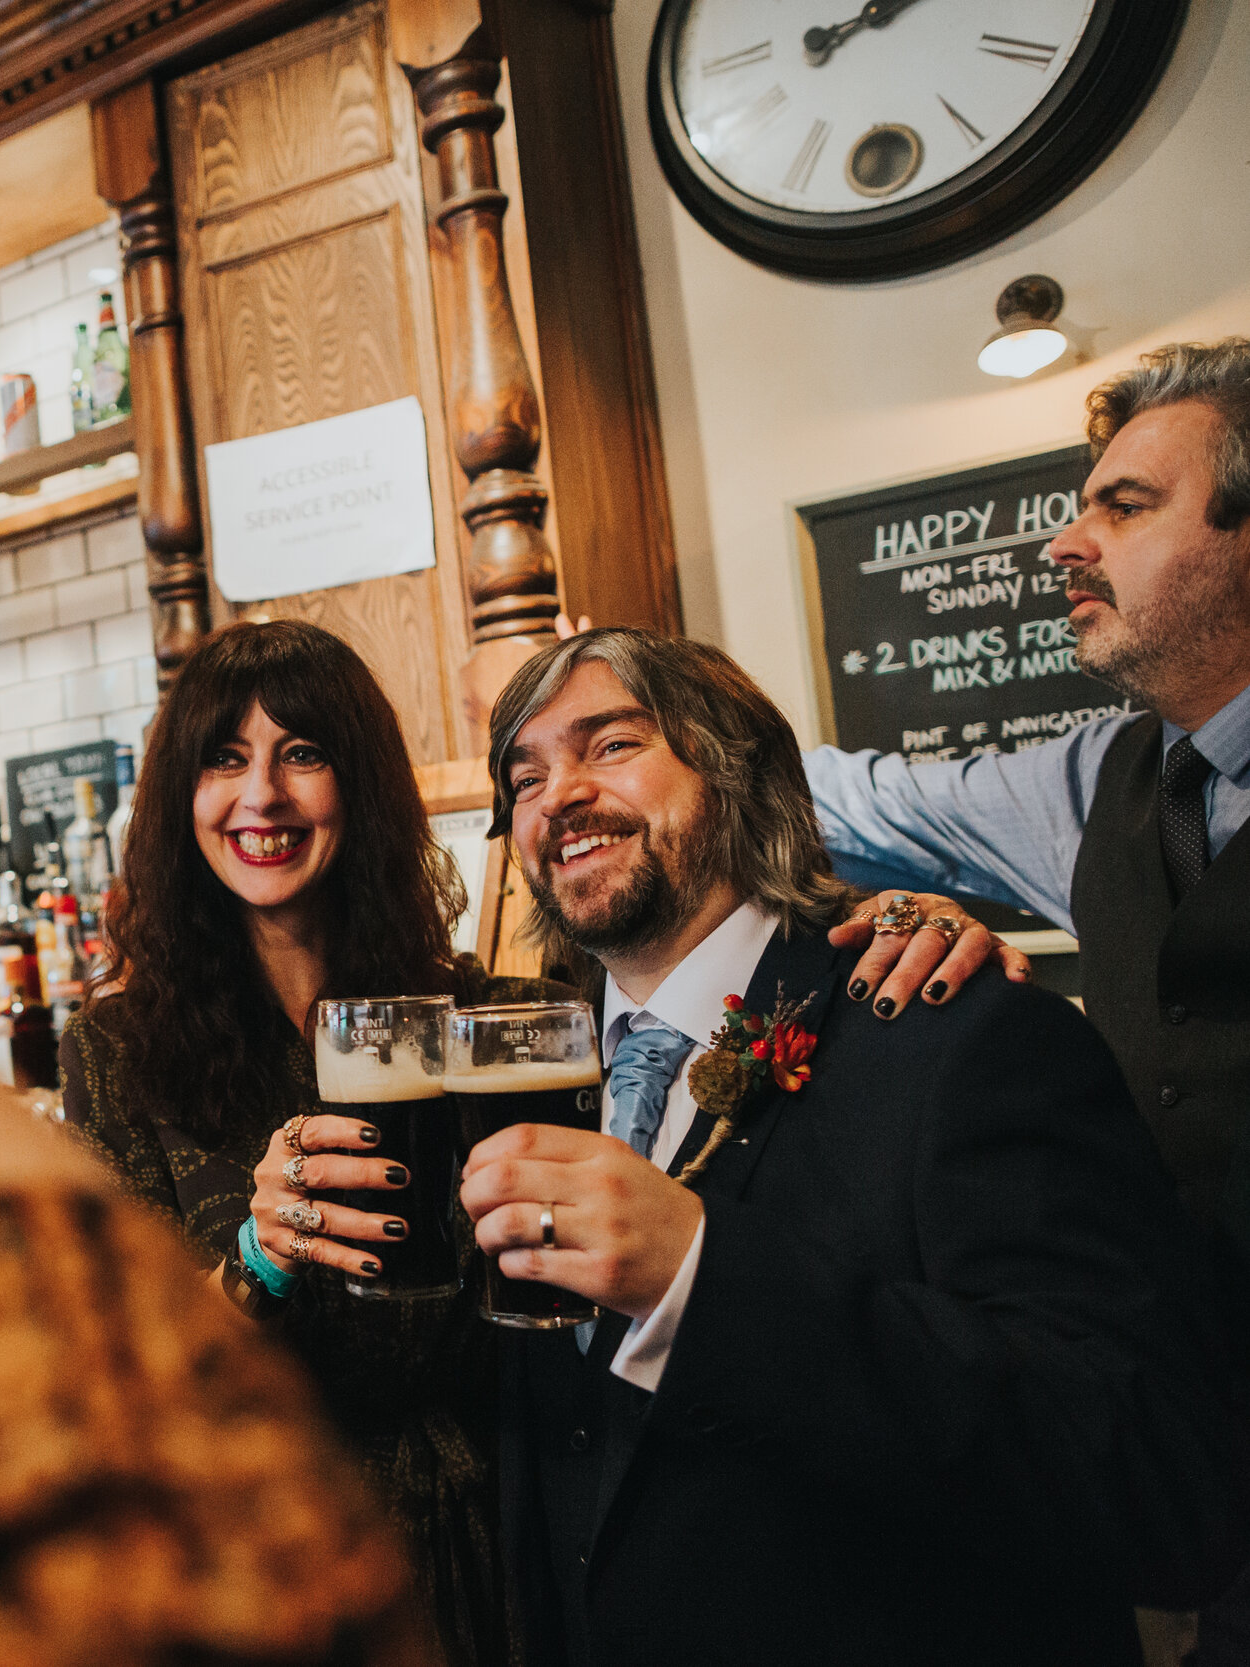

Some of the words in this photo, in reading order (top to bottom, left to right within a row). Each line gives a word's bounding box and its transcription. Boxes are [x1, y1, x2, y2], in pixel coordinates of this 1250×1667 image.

[259, 449, 377, 495] ACCESSIBLE
[244, 497, 324, 534] SERVICE
[329, 481, 396, 513] POINT
[874, 500, 996, 562] HAPPY
[926, 573, 1023, 615] SUNDAY
[875, 641, 907, 674] 2
[910, 625, 1008, 669] DRINKS
[1019, 616, 1079, 649] FOR
[933, 660, 990, 693] MIX
[991, 657, 1016, 684] &
[902, 725, 949, 751] PINT
[961, 721, 989, 742] OF
[358, 1017, 385, 1028] PINT
